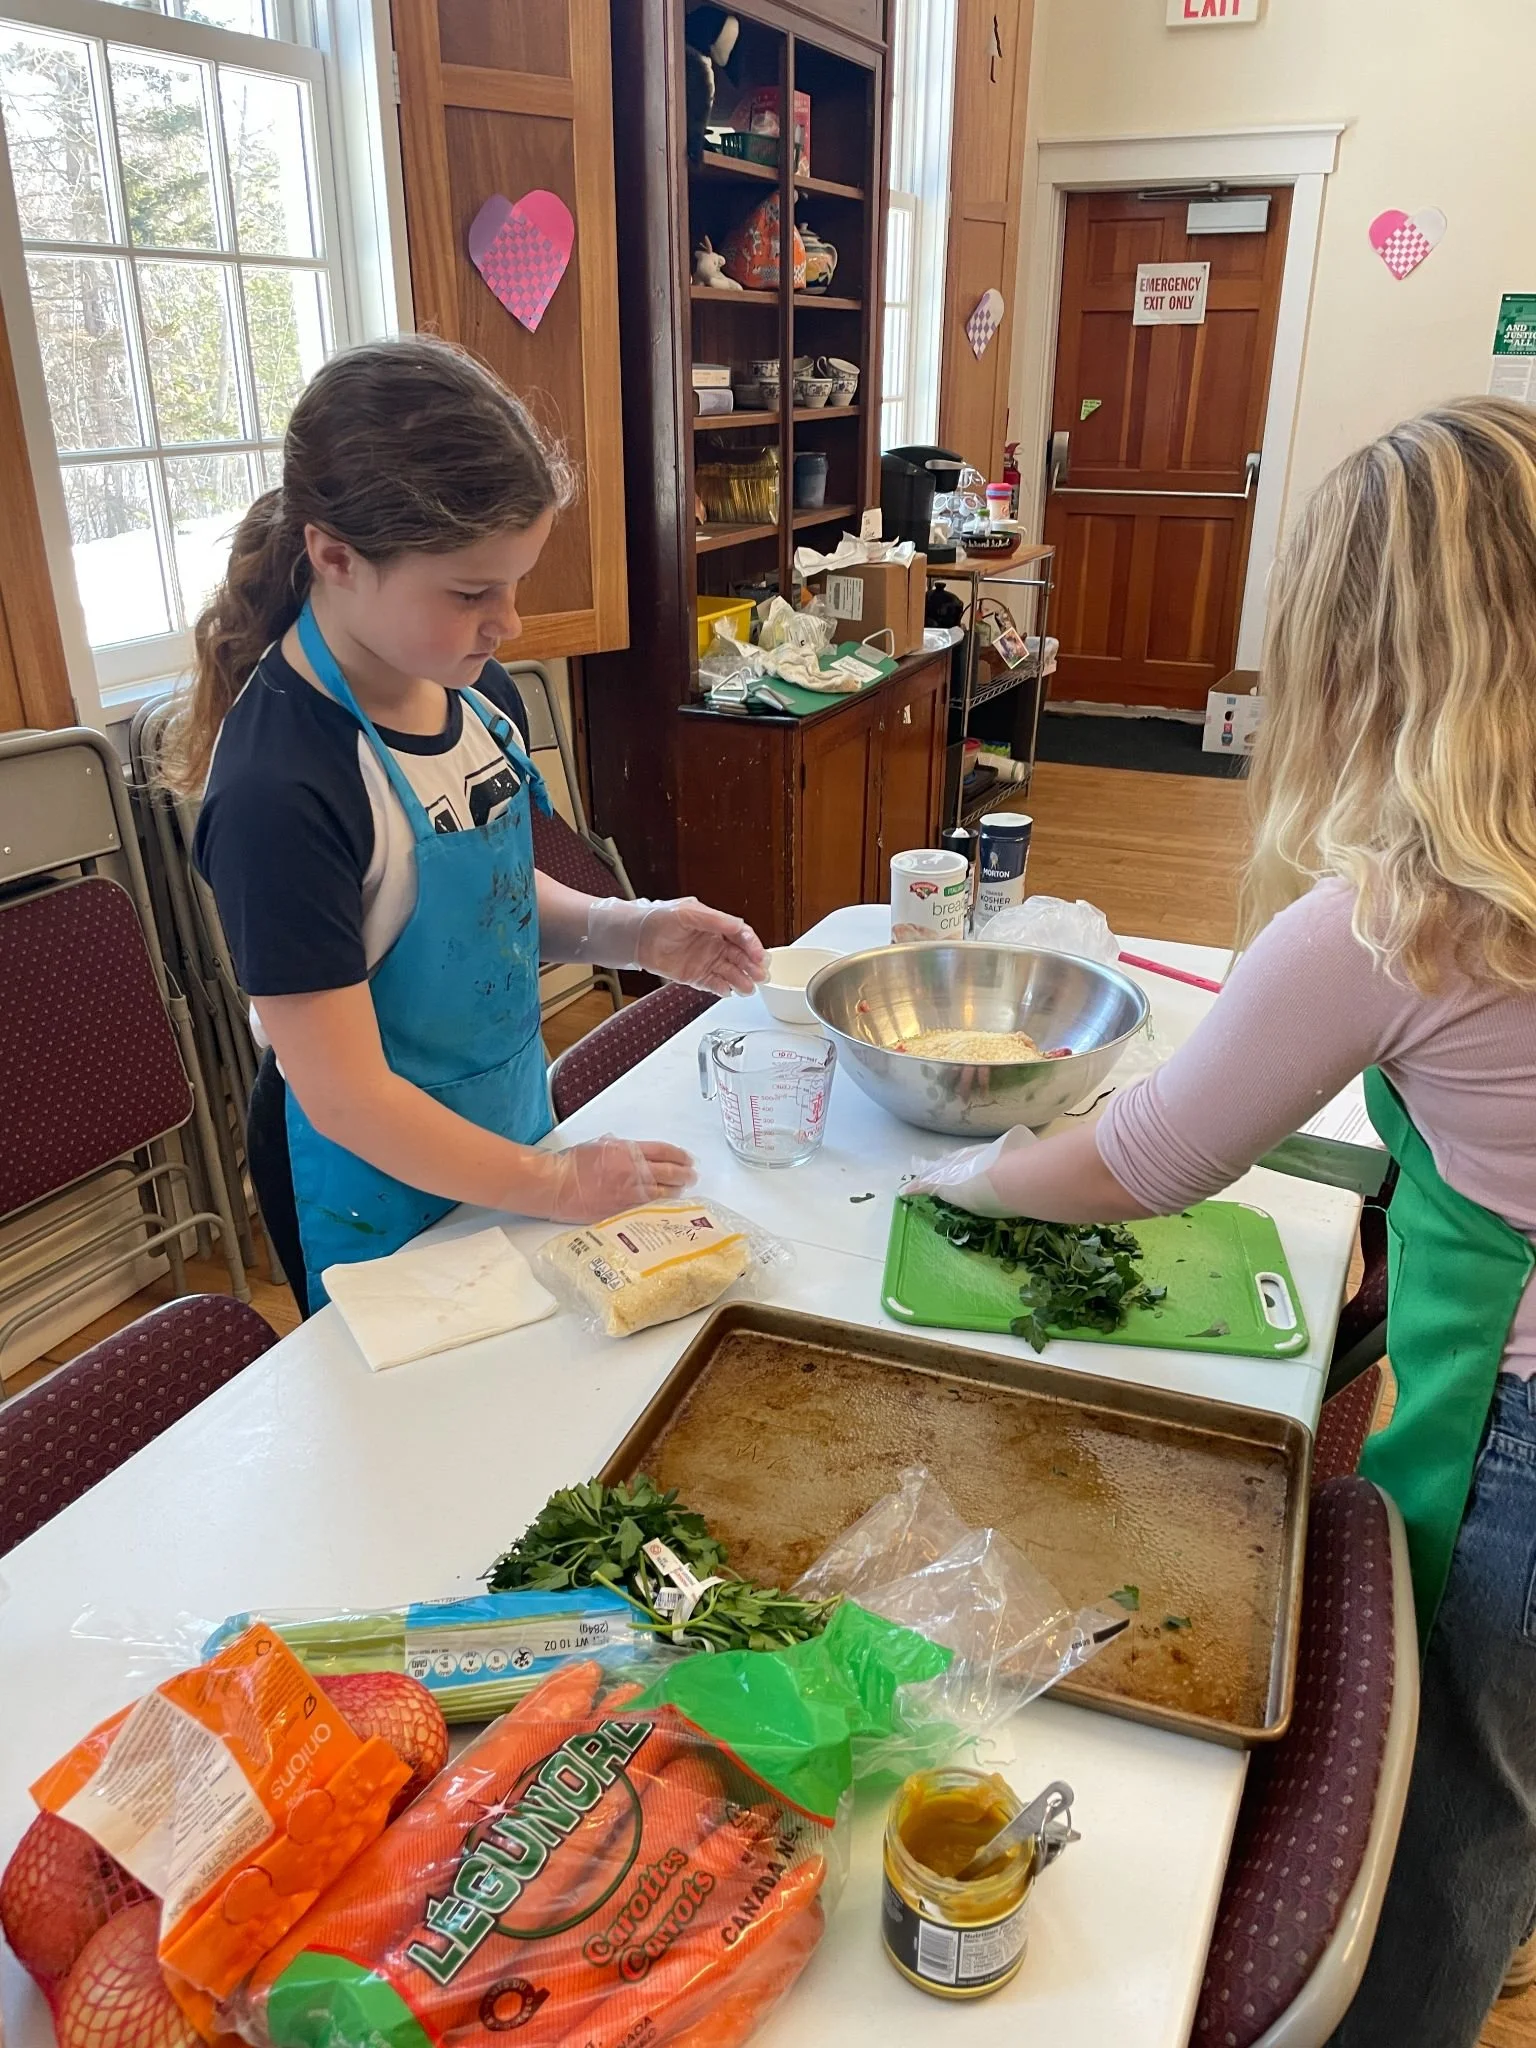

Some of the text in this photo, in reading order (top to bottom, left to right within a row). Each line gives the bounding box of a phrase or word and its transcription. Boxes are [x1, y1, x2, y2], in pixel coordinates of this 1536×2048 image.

[1140, 277, 1201, 292] EMERGENCY
[1144, 295, 1194, 310] EXIT ONLY
[1505, 323, 1527, 331] AND
[1513, 338, 1533, 346] ALL
[983, 867, 1010, 878] MORTON
[981, 894, 1011, 905] KOSHER
[984, 903, 1003, 912] SALT
[579, 1620, 609, 1635] (284g)
[544, 1640, 557, 1651] OZ
[560, 1638, 571, 1649] 10
[575, 1637, 589, 1647] WT
[411, 1659, 428, 1669] GMO
[414, 1669, 425, 1678] NO
[271, 1723, 332, 1800] onions
[583, 1847, 688, 1968] Carottes
[721, 1861, 787, 1945] CANADA
[618, 1870, 716, 1983] Carrots
